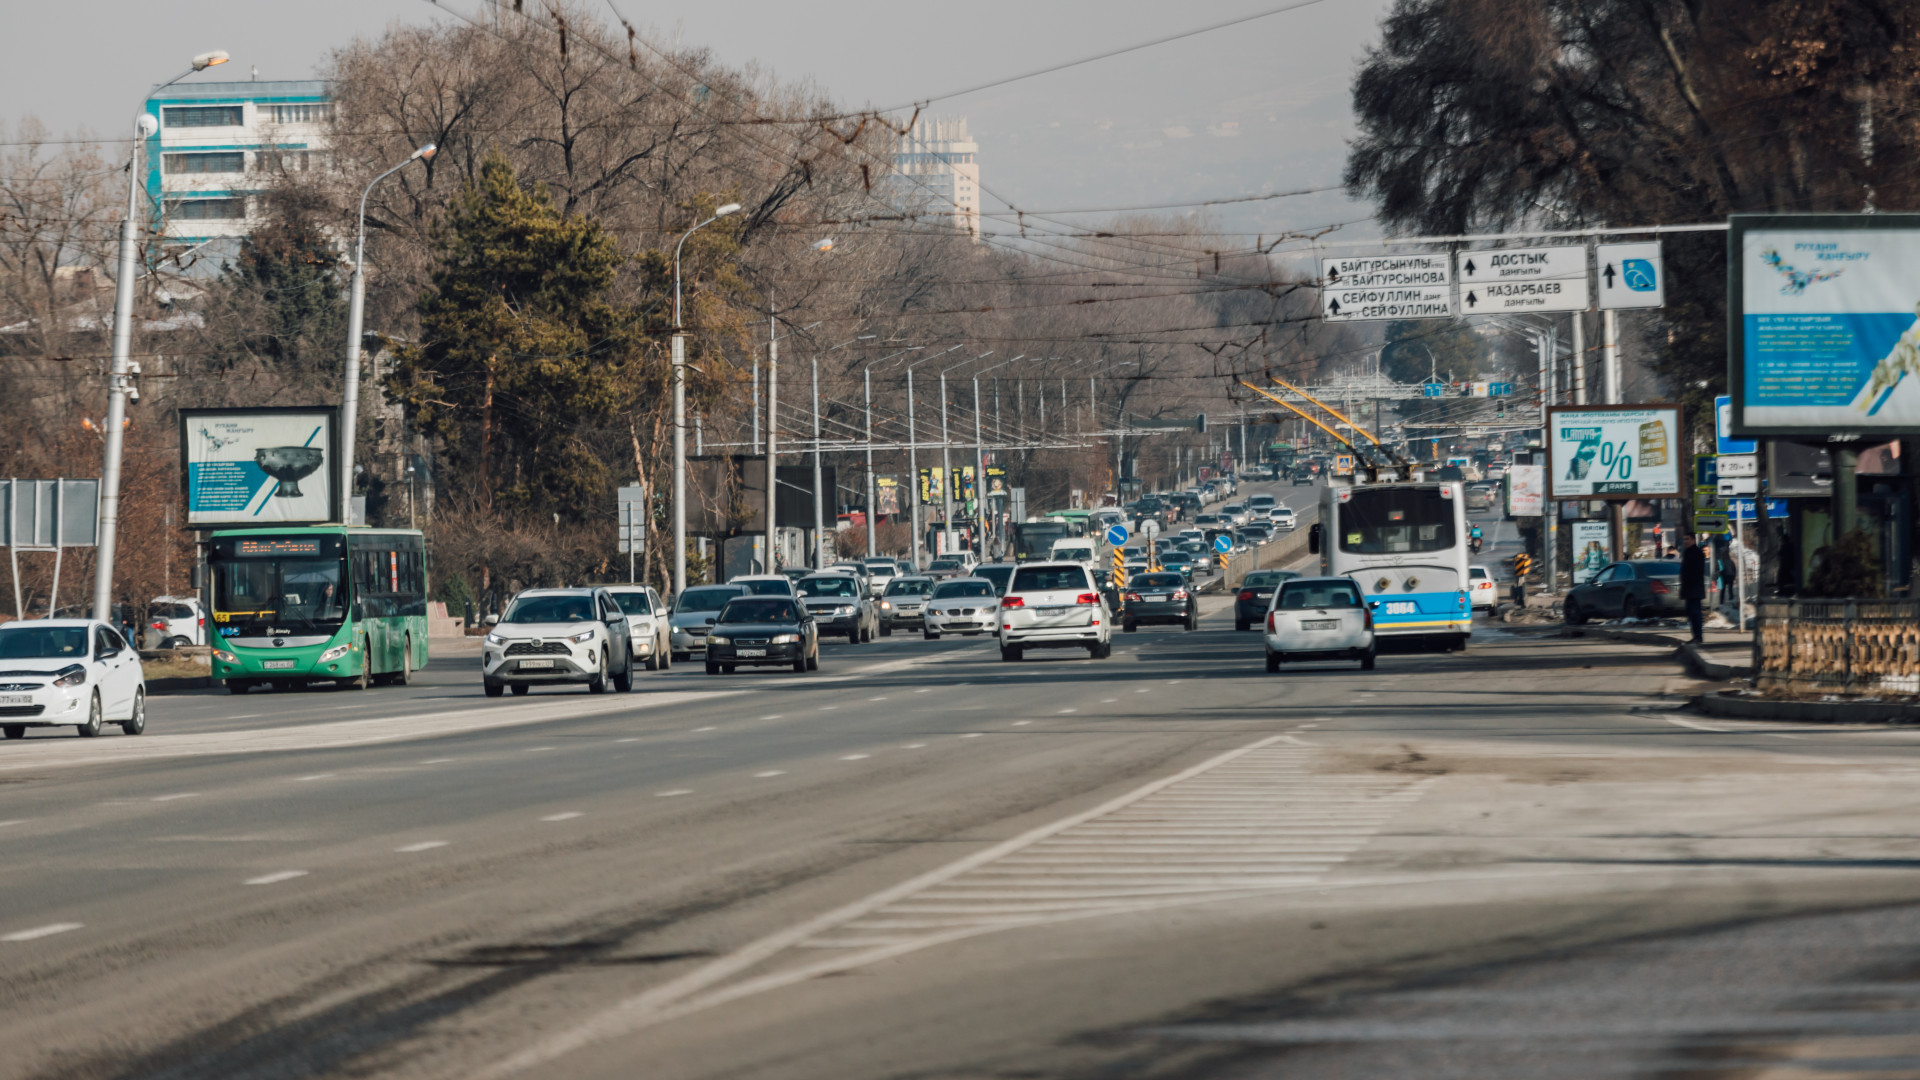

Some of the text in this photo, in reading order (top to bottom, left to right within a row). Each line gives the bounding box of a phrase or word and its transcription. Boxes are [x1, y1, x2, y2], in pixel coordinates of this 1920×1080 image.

[1490, 253, 1549, 268] ДОСТЫҚ
[1487, 282, 1561, 297] НАЗАРБАЕВ
[1342, 290, 1421, 304] СЕЙФУЛЛИН
[1362, 303, 1448, 317] СЕЙФУЛЛИНА
